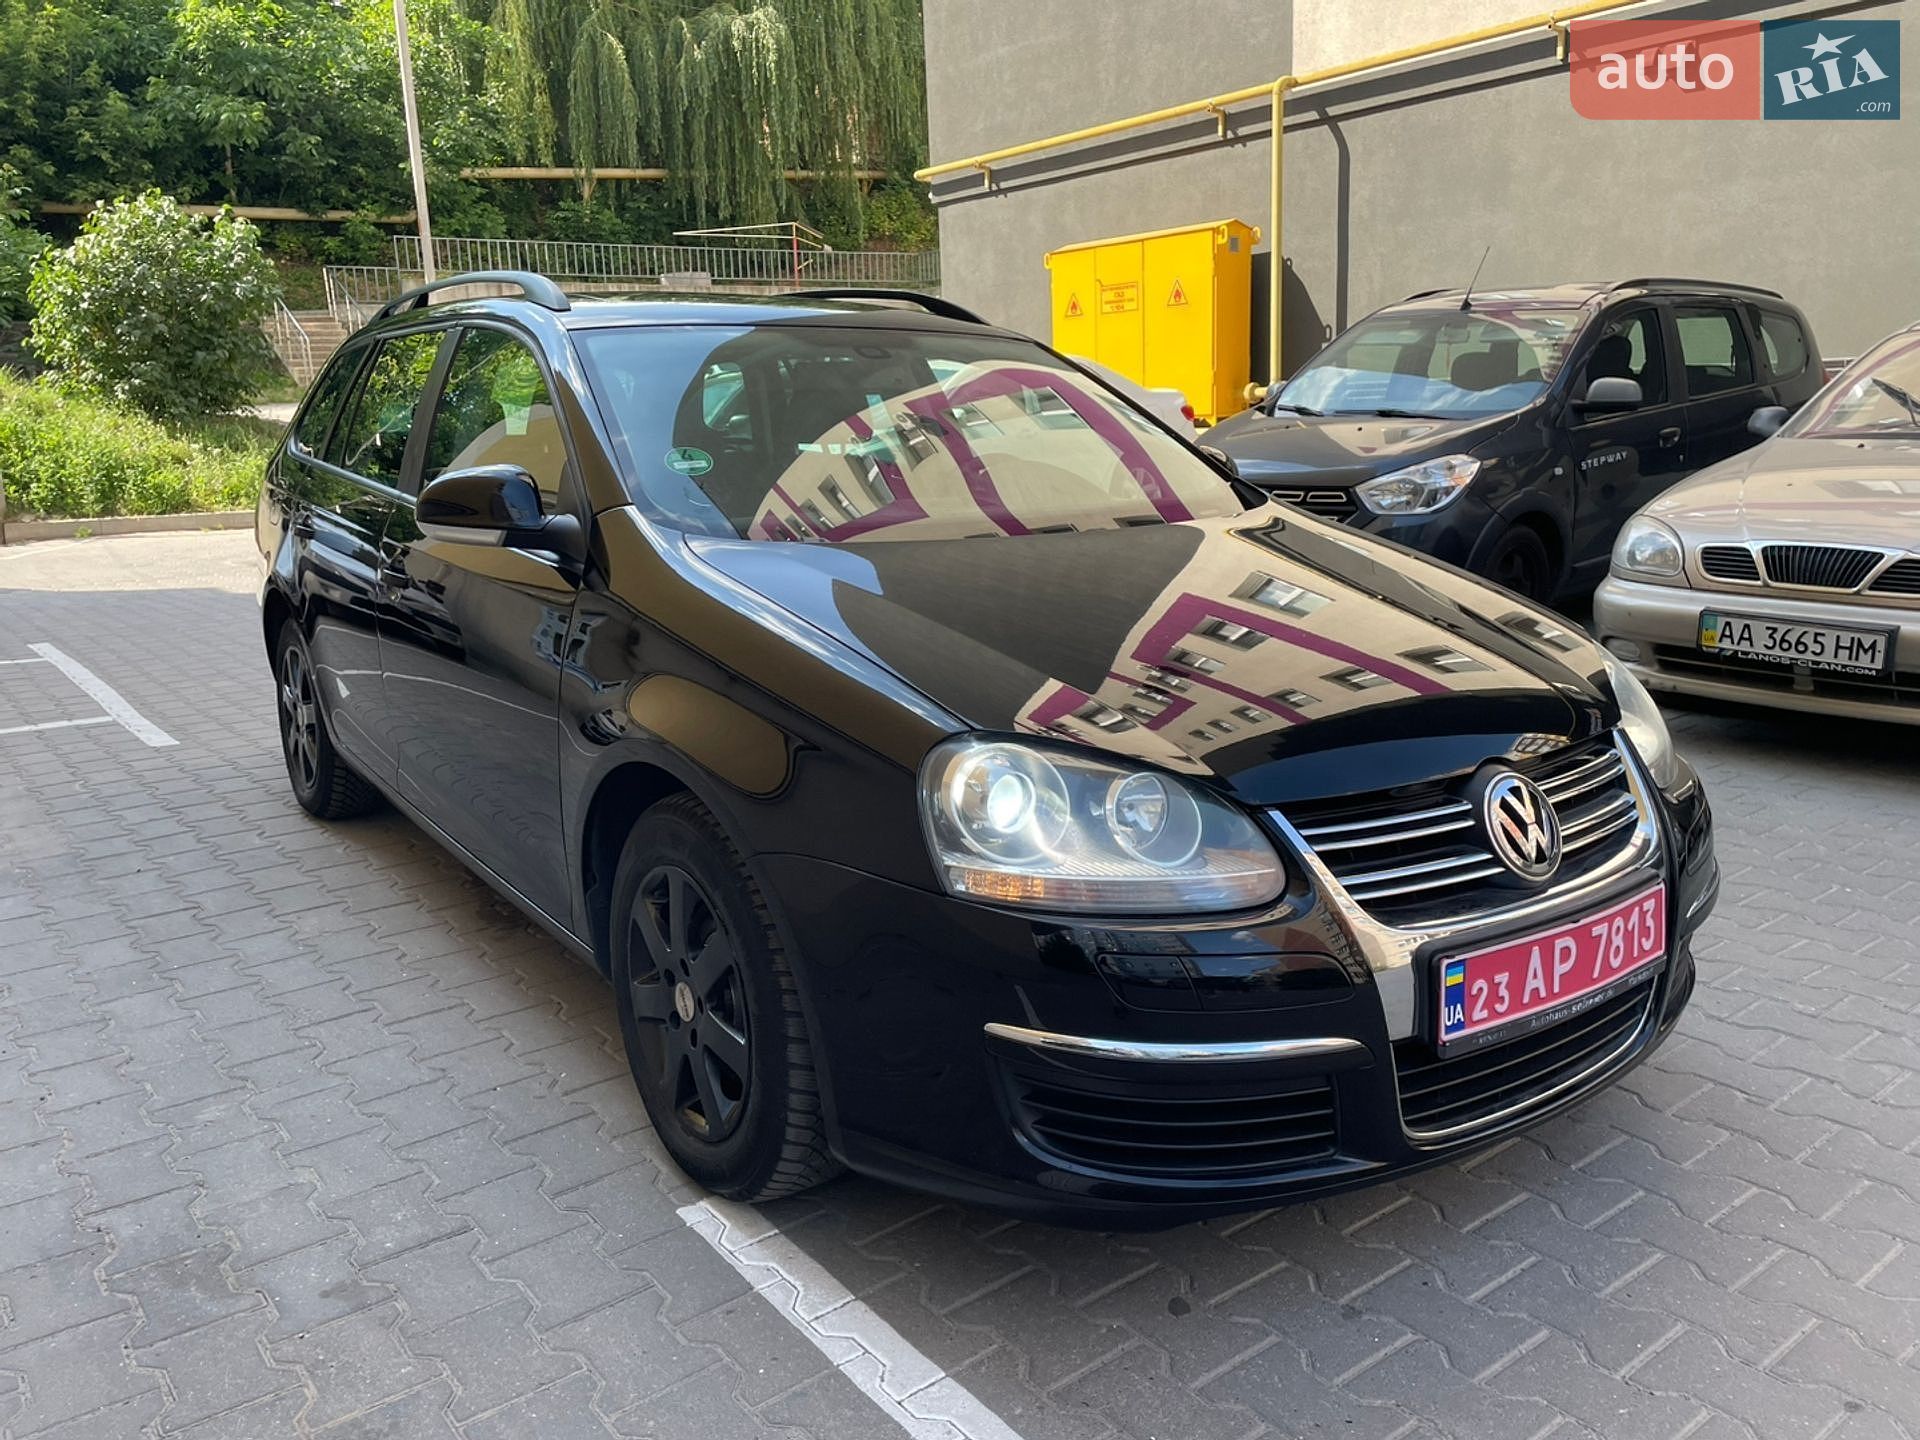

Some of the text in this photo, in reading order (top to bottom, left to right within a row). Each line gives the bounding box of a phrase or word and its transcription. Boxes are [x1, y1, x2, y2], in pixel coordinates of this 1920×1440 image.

[1581, 451, 1627, 470] STEPWAY
[1718, 621, 1879, 664] AA 3665 HM
[1470, 898, 1656, 1022] 23 AP 7813
[1445, 1003, 1464, 1026] UA
